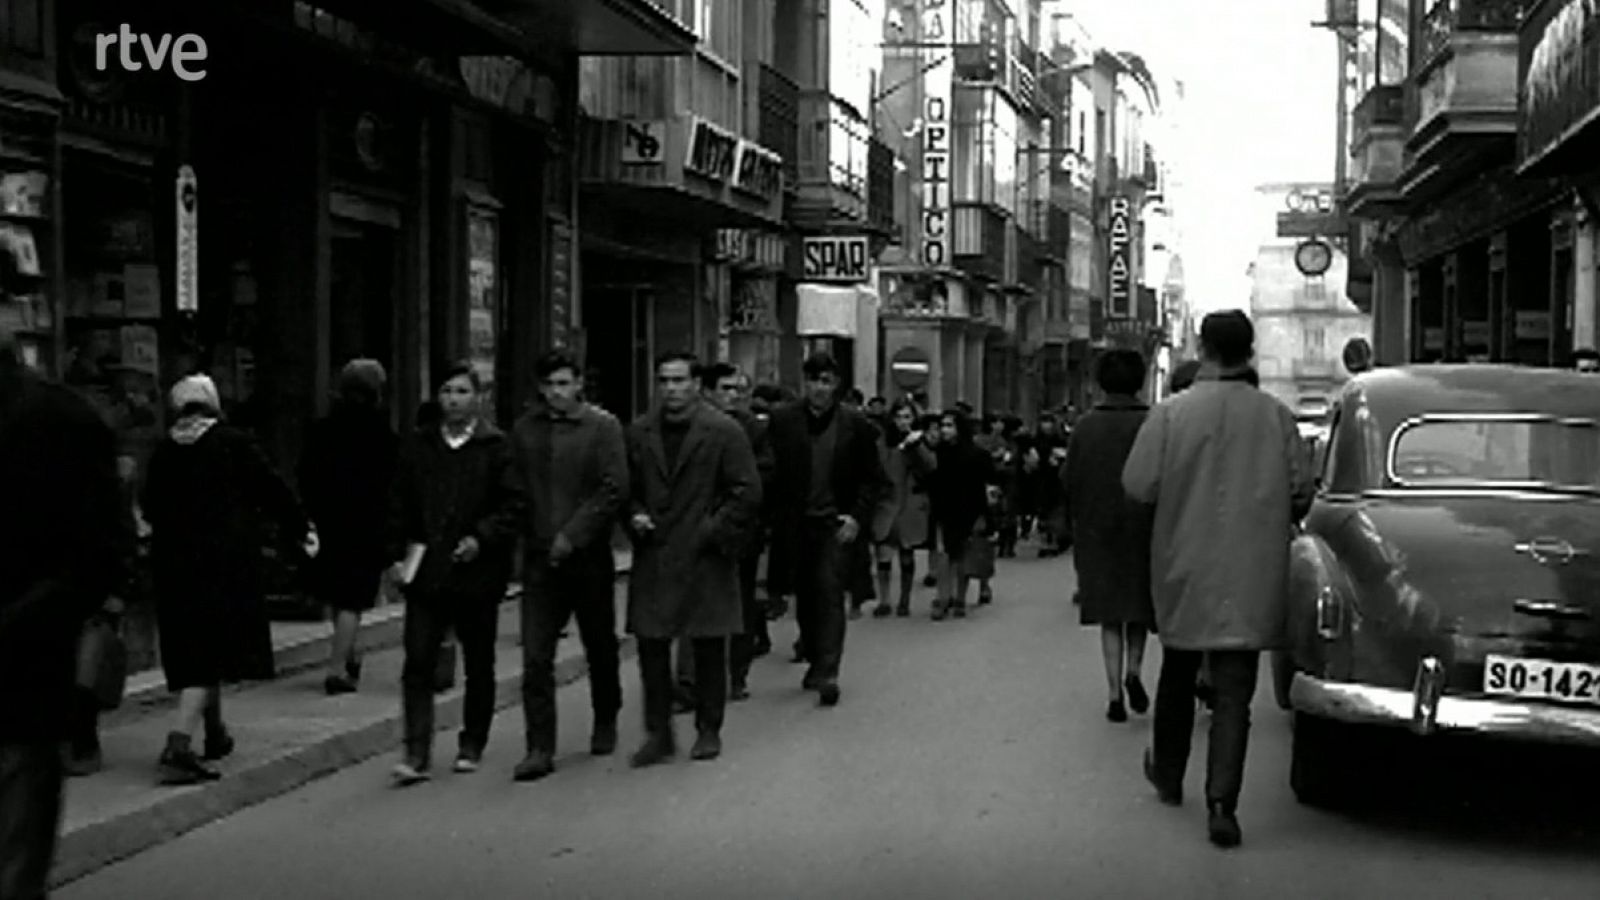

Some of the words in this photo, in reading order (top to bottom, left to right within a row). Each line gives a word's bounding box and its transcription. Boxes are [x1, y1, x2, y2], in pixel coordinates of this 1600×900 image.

[924, 97, 946, 267] OPTICO
[805, 241, 865, 277] SPAR
[1110, 198, 1130, 318] RAFAEL
